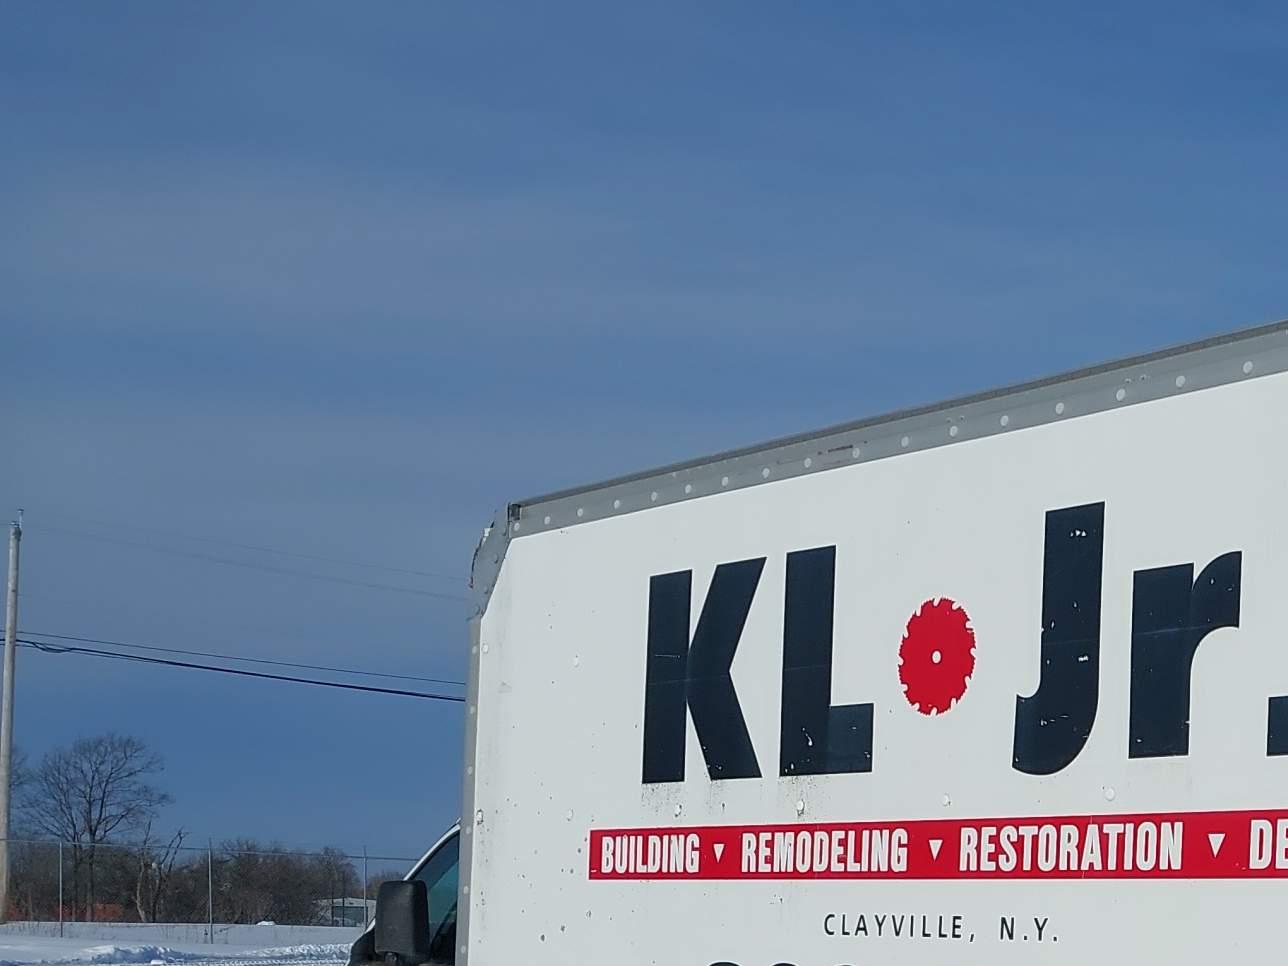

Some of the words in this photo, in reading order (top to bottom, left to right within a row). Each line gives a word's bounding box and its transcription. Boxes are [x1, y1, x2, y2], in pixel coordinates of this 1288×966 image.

[641, 544, 874, 785] KL
[600, 832, 700, 874] BUILDING
[740, 828, 909, 873] REMODELING
[959, 821, 1185, 872] RESTORATION
[823, 913, 976, 943] CLAYVILLE,
[1000, 916, 1059, 942] N.Y.
